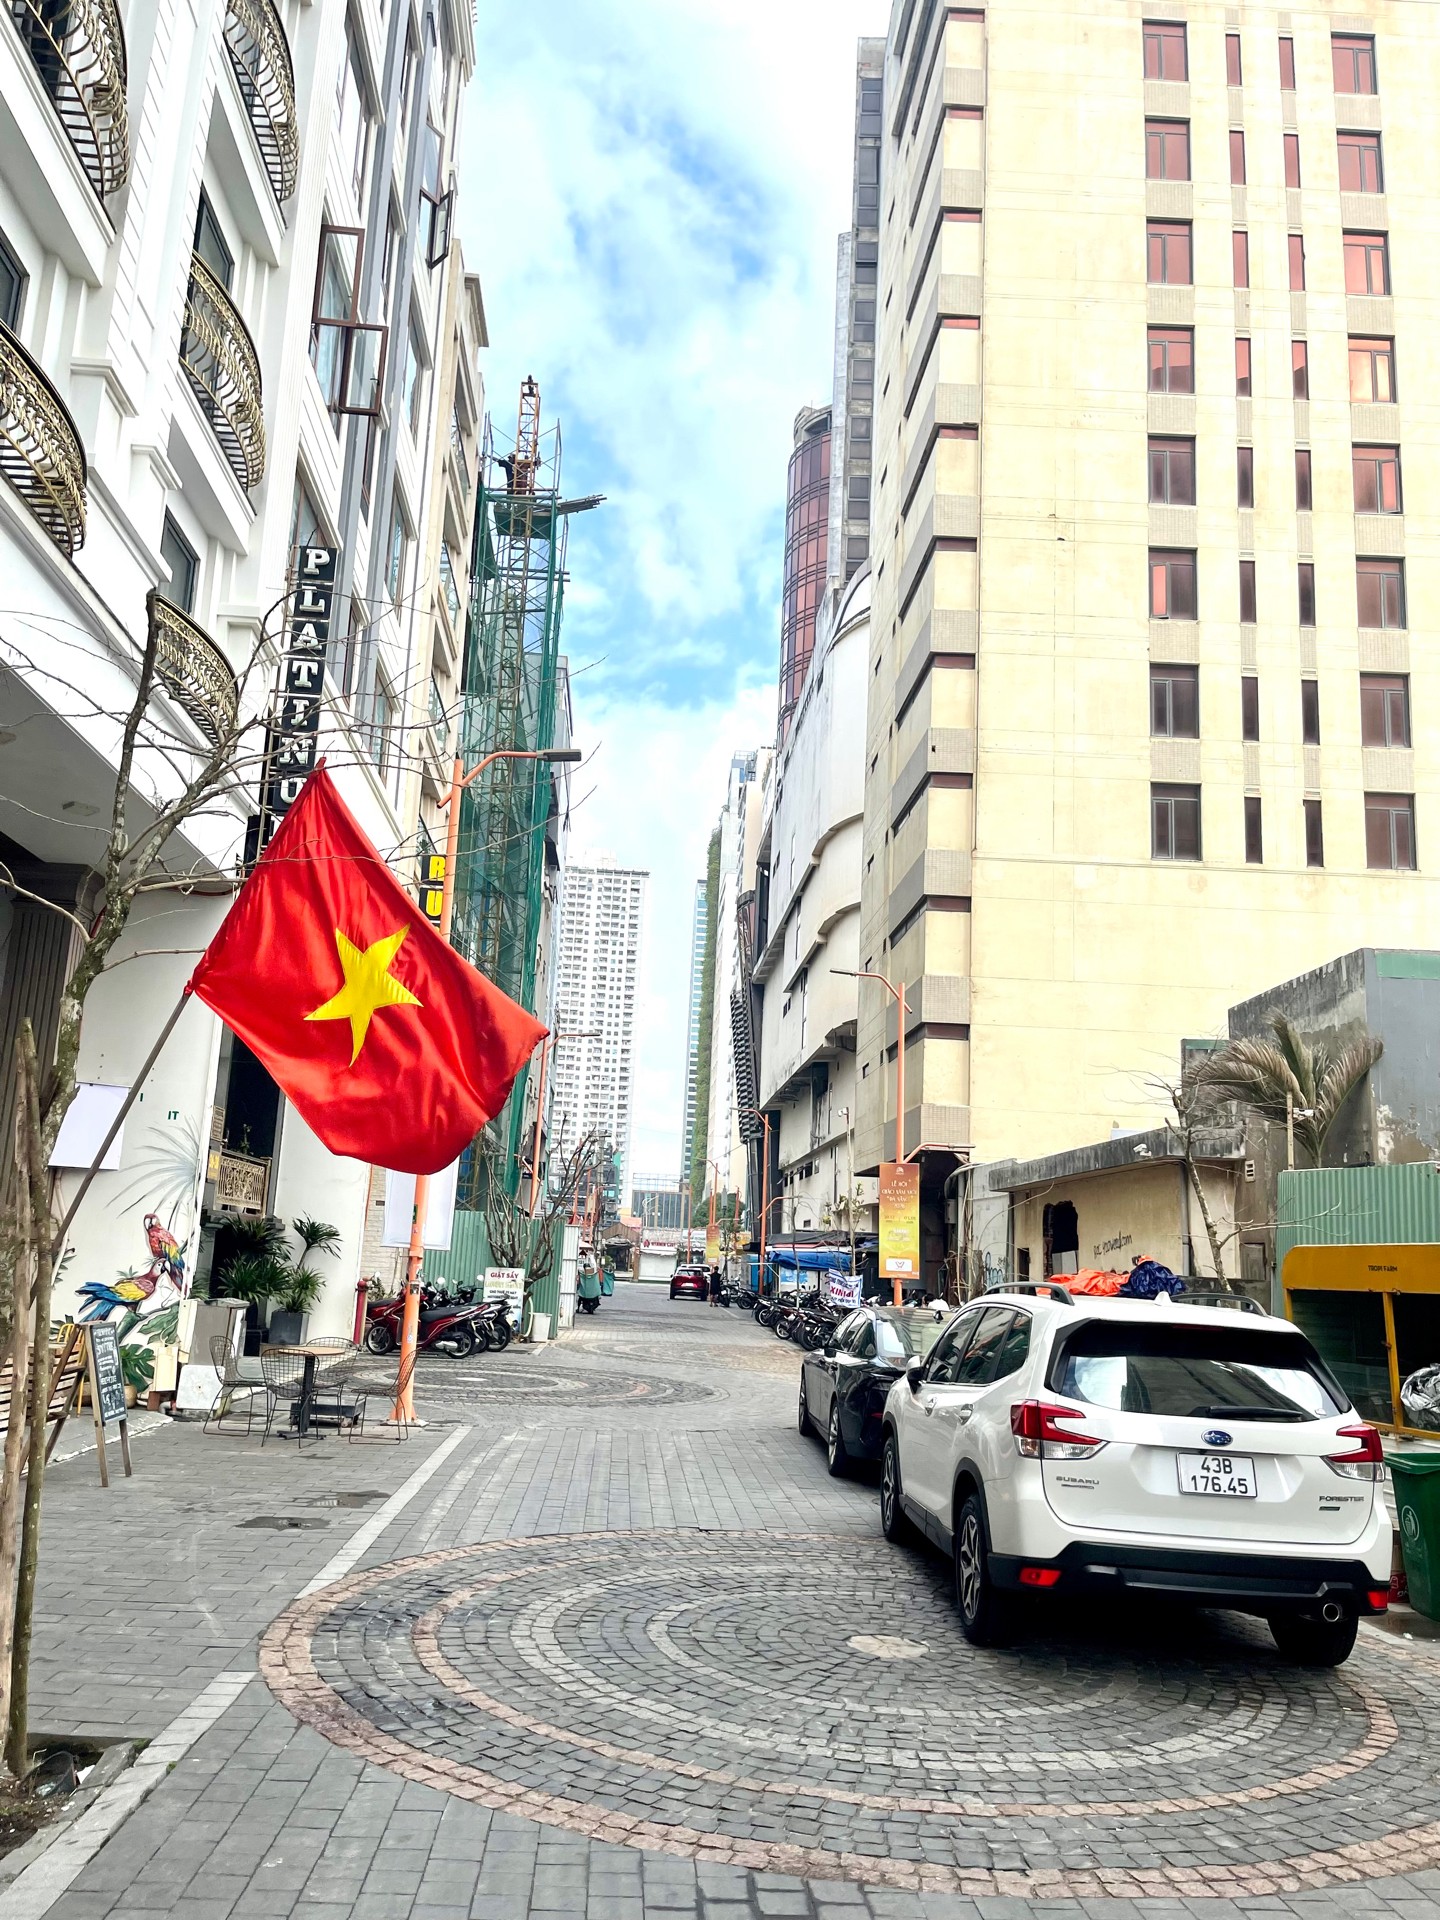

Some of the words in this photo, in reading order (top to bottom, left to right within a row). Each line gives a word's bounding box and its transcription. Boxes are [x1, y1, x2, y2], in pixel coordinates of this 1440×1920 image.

[1201, 1457, 1233, 1475] 43B
[1056, 1476, 1099, 1485] SUBARU
[1191, 1474, 1249, 1495] 176.45
